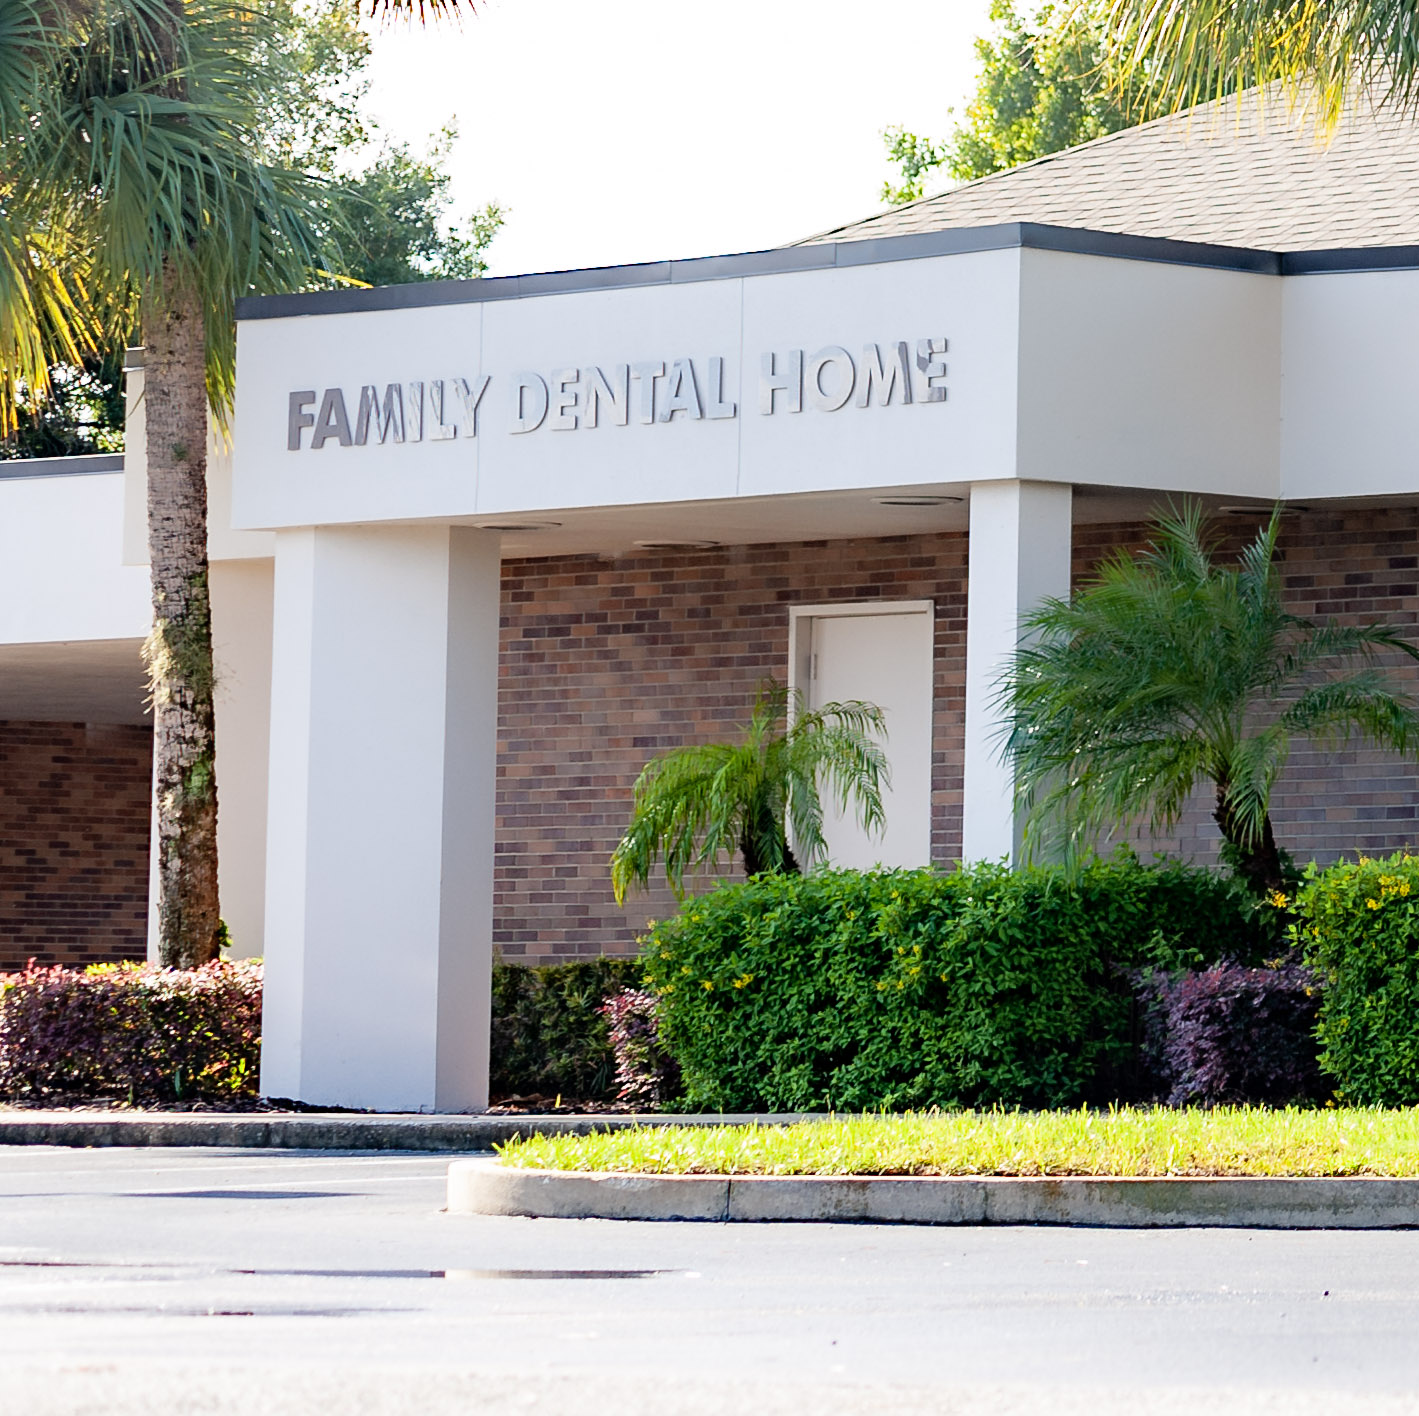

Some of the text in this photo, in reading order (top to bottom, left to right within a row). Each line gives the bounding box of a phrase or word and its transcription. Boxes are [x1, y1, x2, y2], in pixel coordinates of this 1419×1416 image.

[287, 337, 948, 451] FAMILY DENTAL HOME
